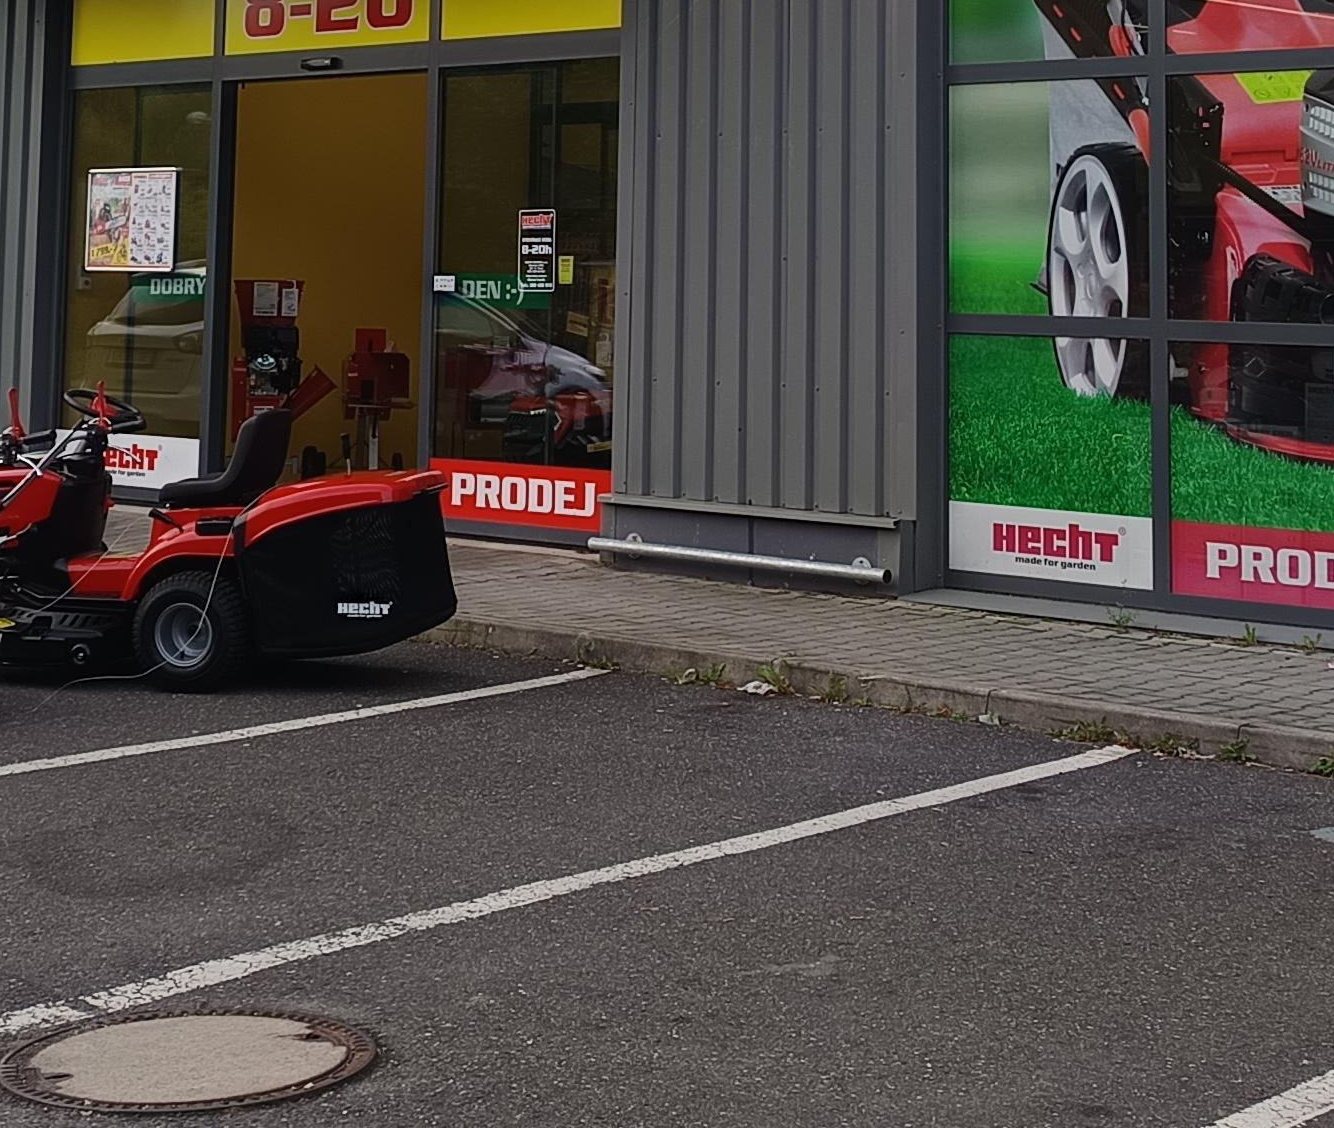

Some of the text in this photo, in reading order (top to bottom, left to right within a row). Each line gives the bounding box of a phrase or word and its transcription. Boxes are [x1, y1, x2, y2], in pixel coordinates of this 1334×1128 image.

[462, 279, 501, 300] DEN
[103, 443, 159, 471] echT
[451, 472, 596, 517] PRODEJ
[1015, 556, 1097, 571] made for garden
